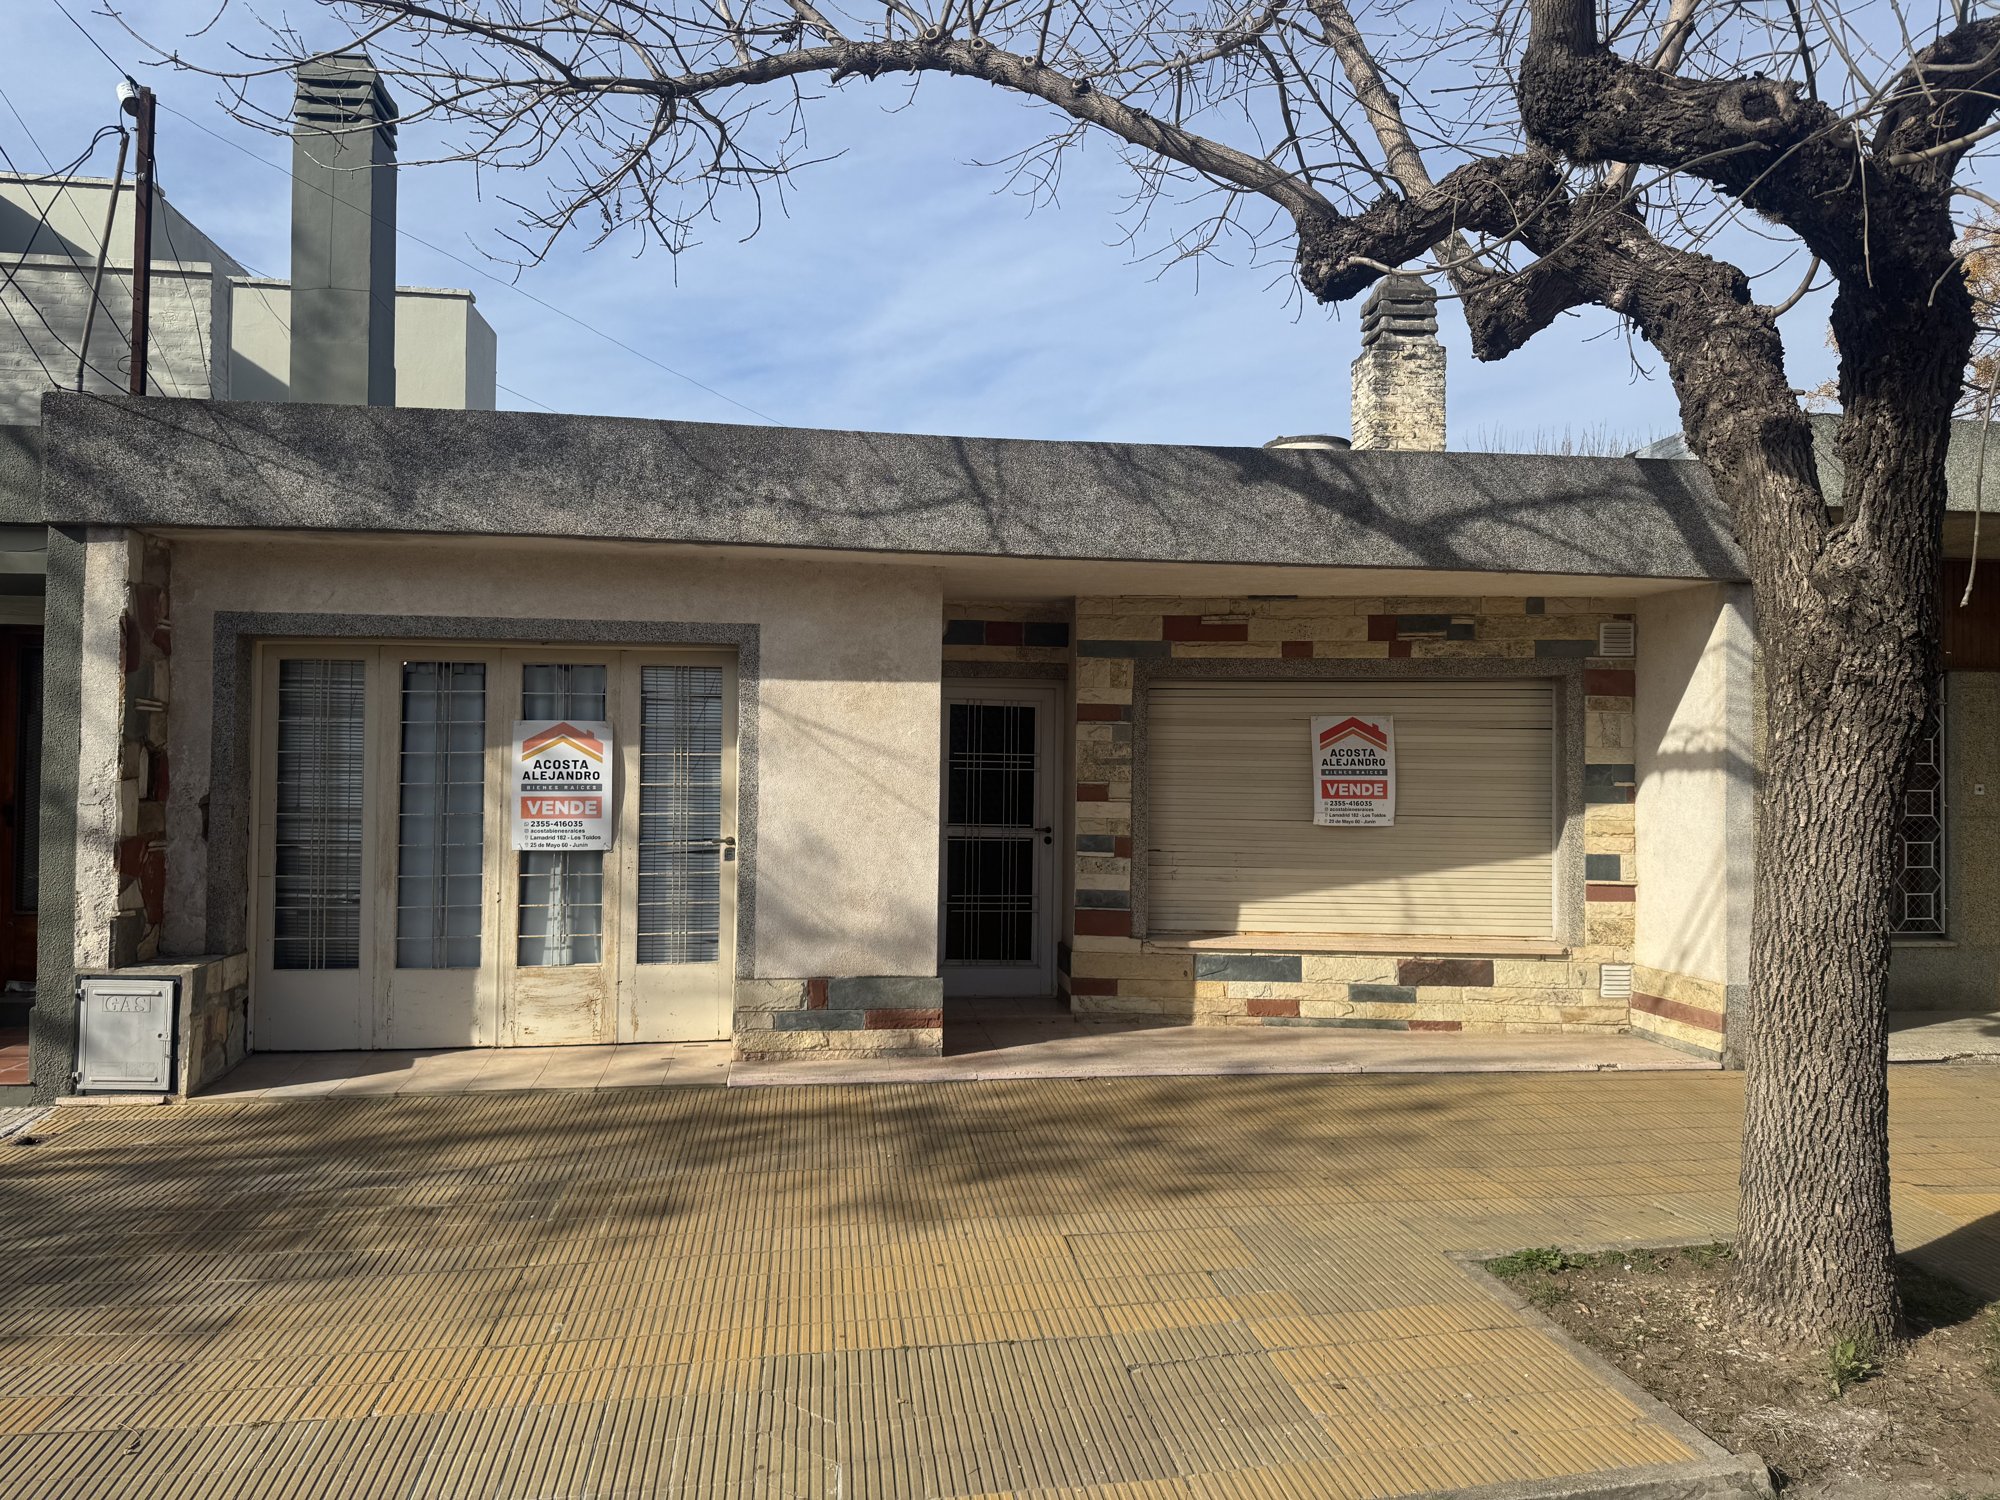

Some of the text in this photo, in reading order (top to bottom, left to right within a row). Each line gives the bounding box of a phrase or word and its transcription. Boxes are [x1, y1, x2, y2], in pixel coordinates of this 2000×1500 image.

[1330, 749, 1376, 757] ACOSTA
[533, 760, 588, 769] ACOSTA
[522, 771, 600, 780] ALEJANDRO
[1326, 783, 1384, 796] VENDE
[526, 800, 597, 815] VENDE
[105, 996, 146, 1012] GAS
